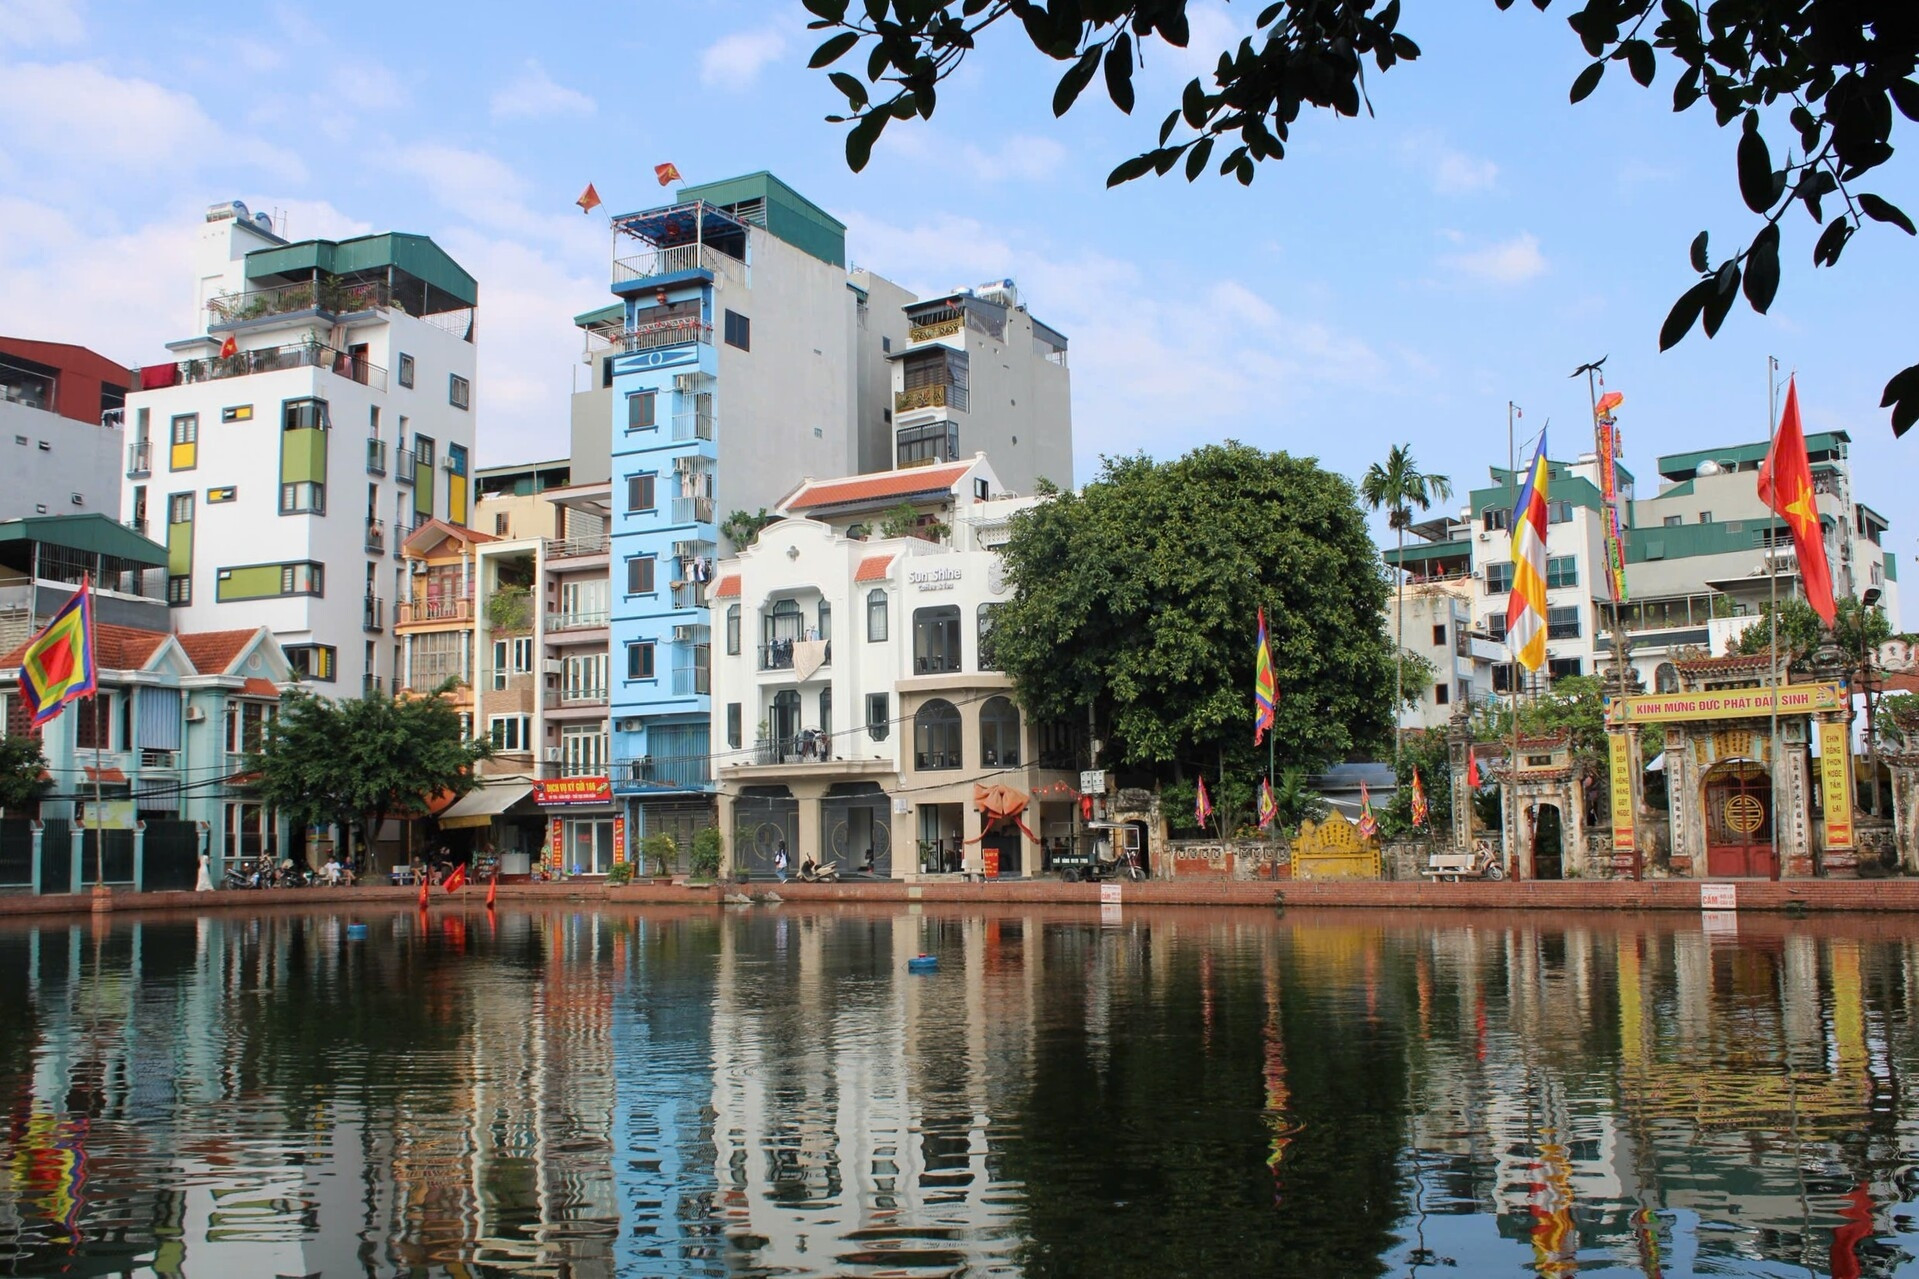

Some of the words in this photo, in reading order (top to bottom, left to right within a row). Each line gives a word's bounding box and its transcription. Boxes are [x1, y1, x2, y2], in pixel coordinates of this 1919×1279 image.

[909, 571, 929, 584] Sun
[933, 568, 962, 582] Shine
[1636, 702, 1661, 715] KÍNH
[1699, 698, 1720, 711] ĐỨC
[1723, 696, 1751, 710] PHẬT
[1782, 694, 1809, 705] SINH
